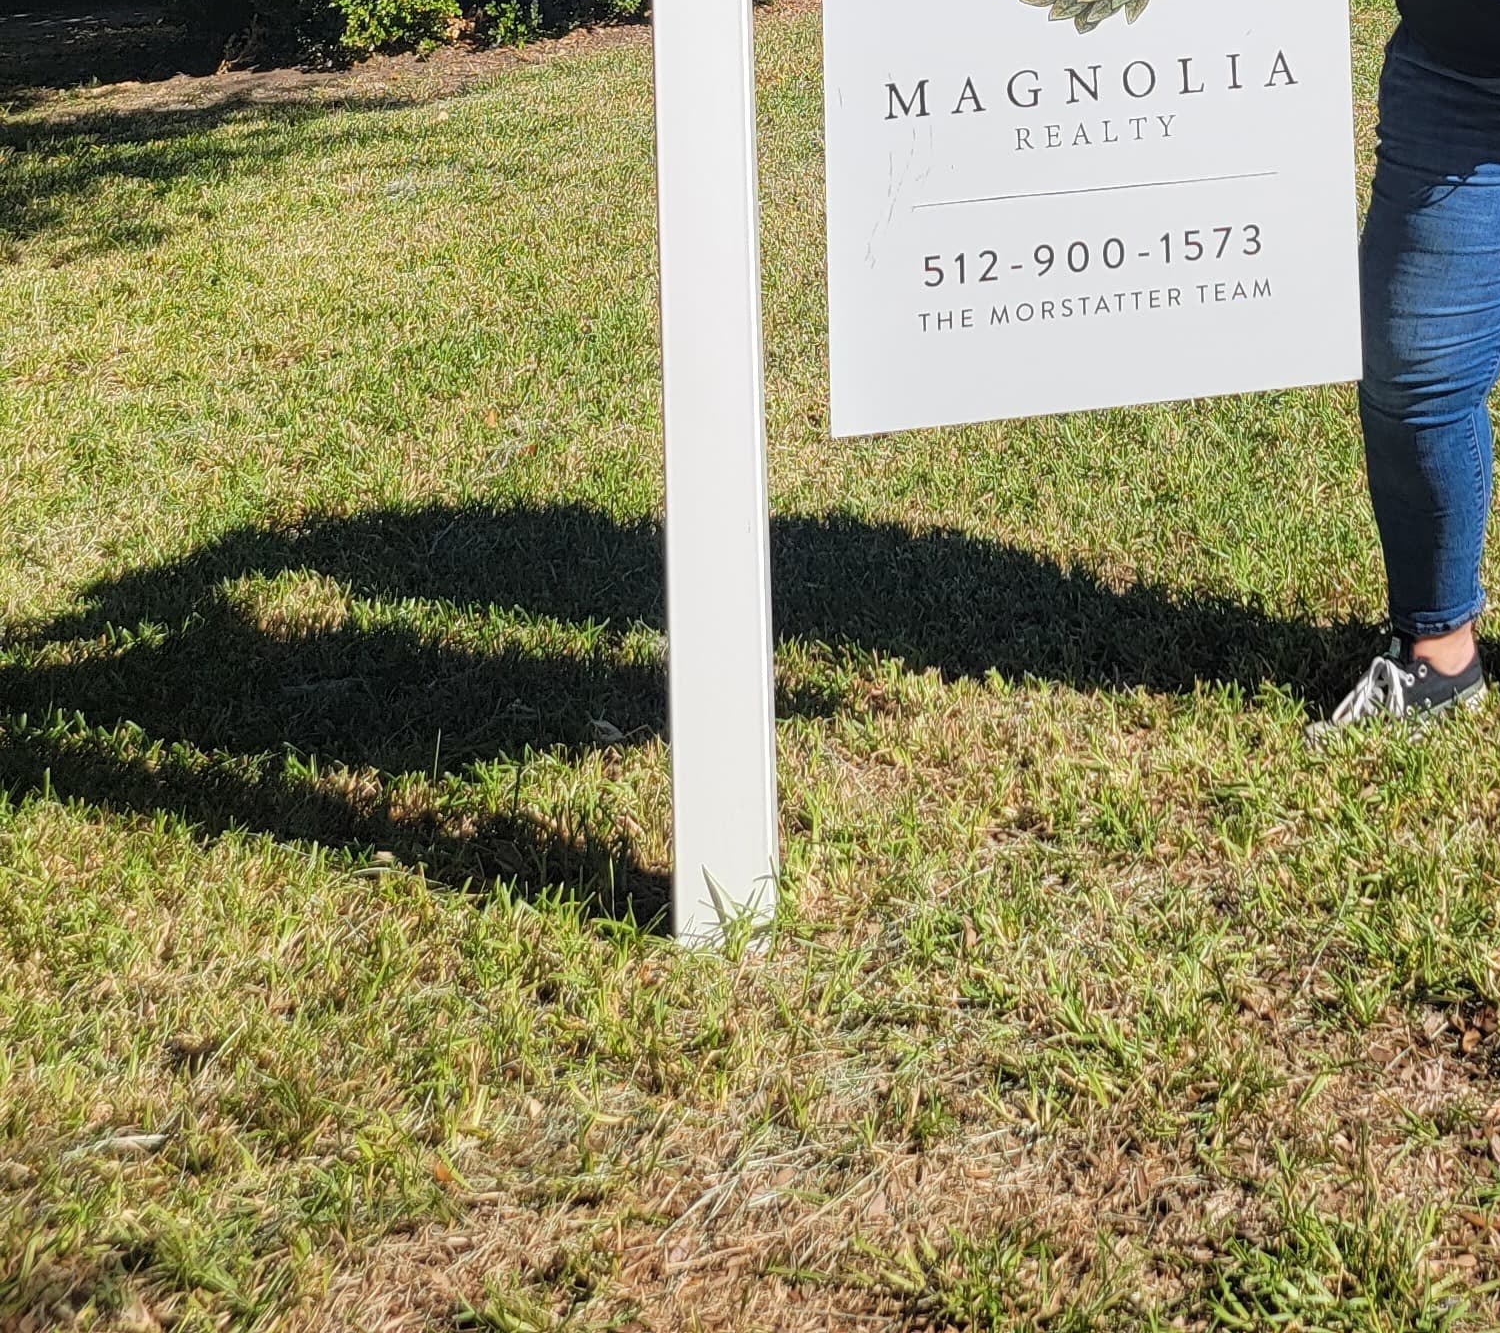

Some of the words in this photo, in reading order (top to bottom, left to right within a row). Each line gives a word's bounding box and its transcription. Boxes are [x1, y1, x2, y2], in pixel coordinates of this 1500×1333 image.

[884, 50, 1298, 120] MAGNOLIA
[1014, 114, 1177, 151] REALTY
[923, 224, 1263, 288] 512-900-1573
[918, 307, 975, 332] THE
[990, 287, 1183, 327] MORSTATTER
[1196, 277, 1274, 303] TEAM
